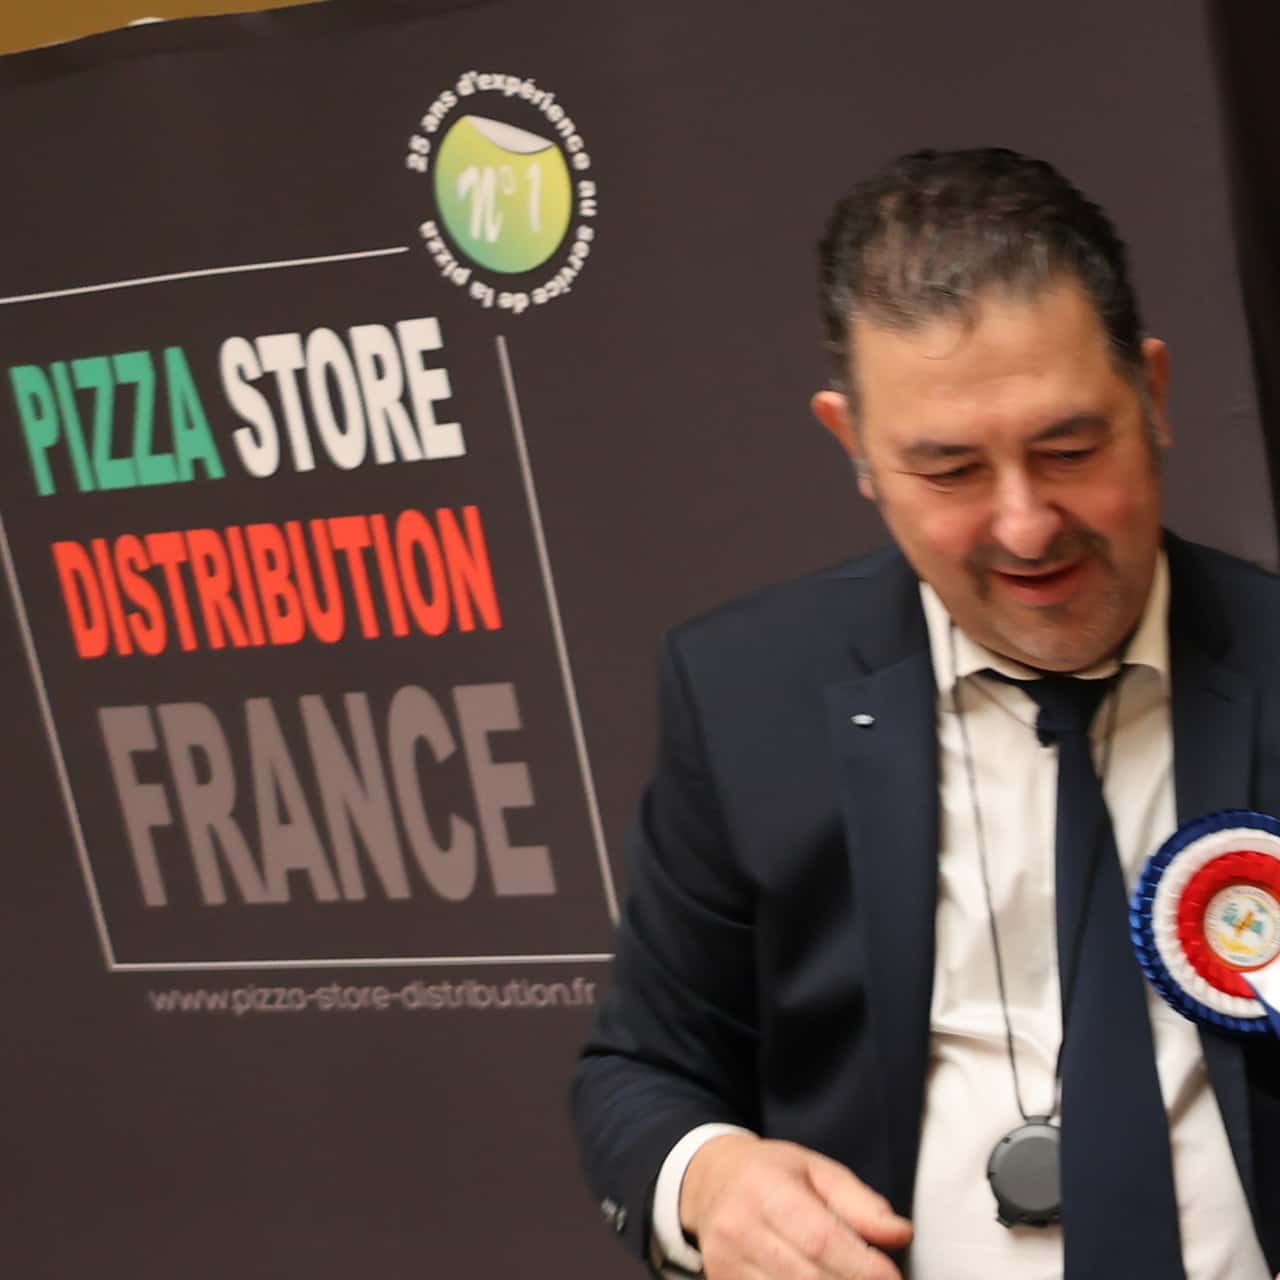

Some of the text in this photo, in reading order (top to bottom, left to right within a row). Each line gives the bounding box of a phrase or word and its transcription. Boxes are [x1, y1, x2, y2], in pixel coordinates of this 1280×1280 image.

[421, 90, 457, 133] ans
[456, 70, 591, 170] d'expérience
[578, 180, 597, 217] au
[419, 220, 472, 286] pizza
[532, 225, 594, 304] service
[469, 281, 495, 308] la
[497, 292, 529, 314] de
[9, 316, 466, 496] PIZZA STORE
[52, 505, 502, 659] DISTRIBUTION
[98, 682, 556, 906] FRANCE
